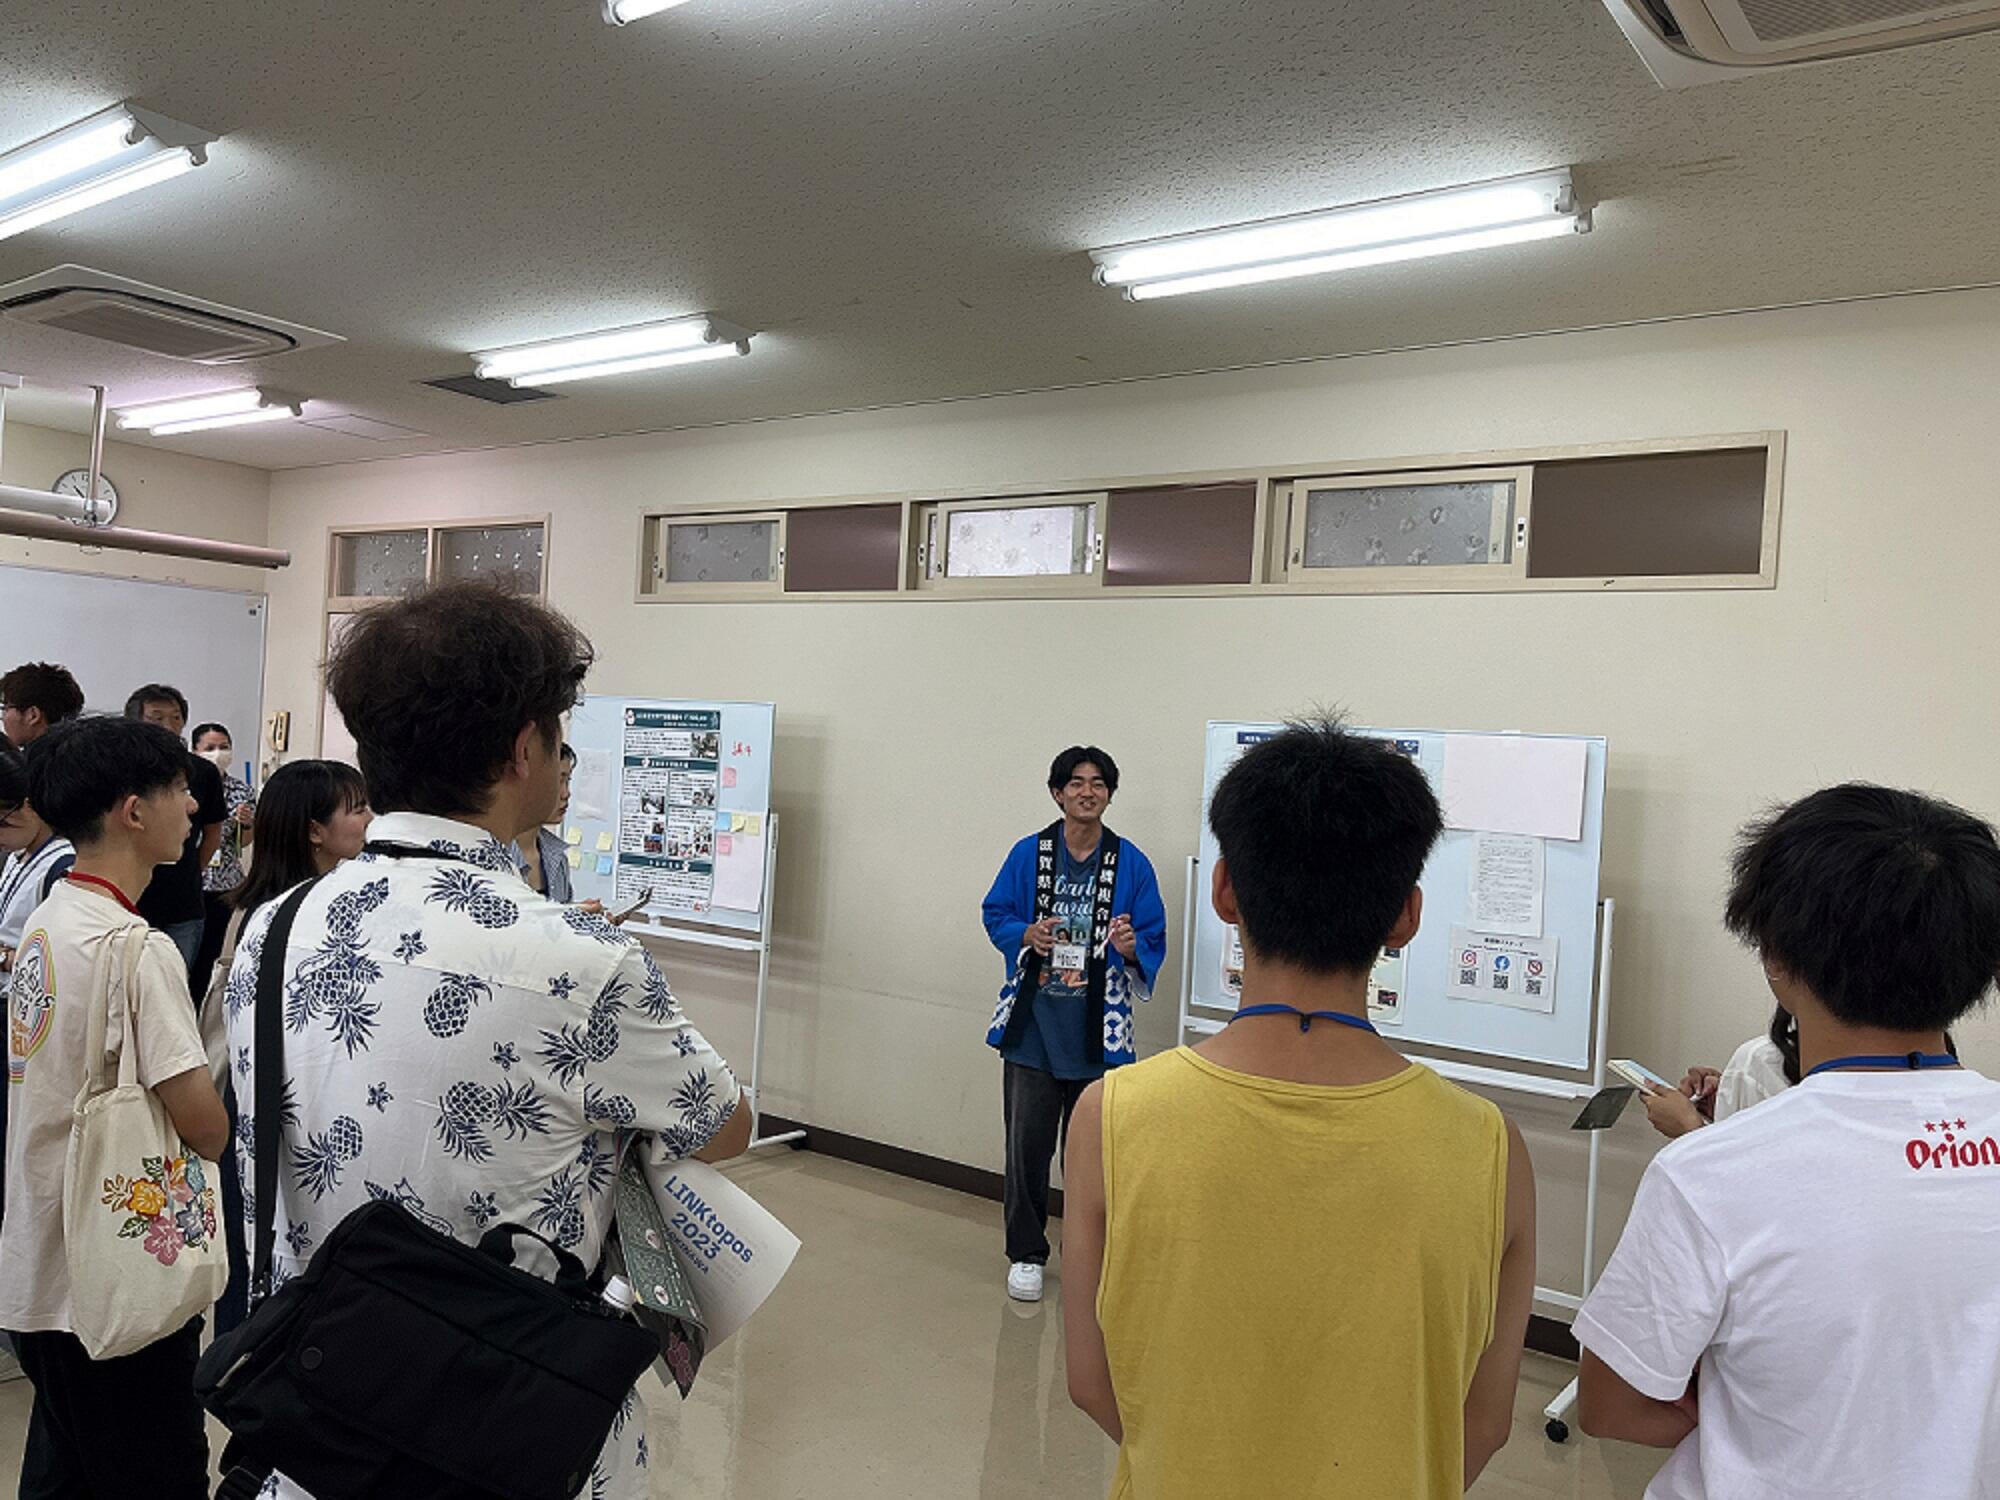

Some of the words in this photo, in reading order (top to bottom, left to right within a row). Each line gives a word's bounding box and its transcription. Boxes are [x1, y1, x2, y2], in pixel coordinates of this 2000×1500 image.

[1905, 1132, 2000, 1170] Orion
[664, 1175, 753, 1263] LINKtopos
[671, 1212, 721, 1259] 2023
